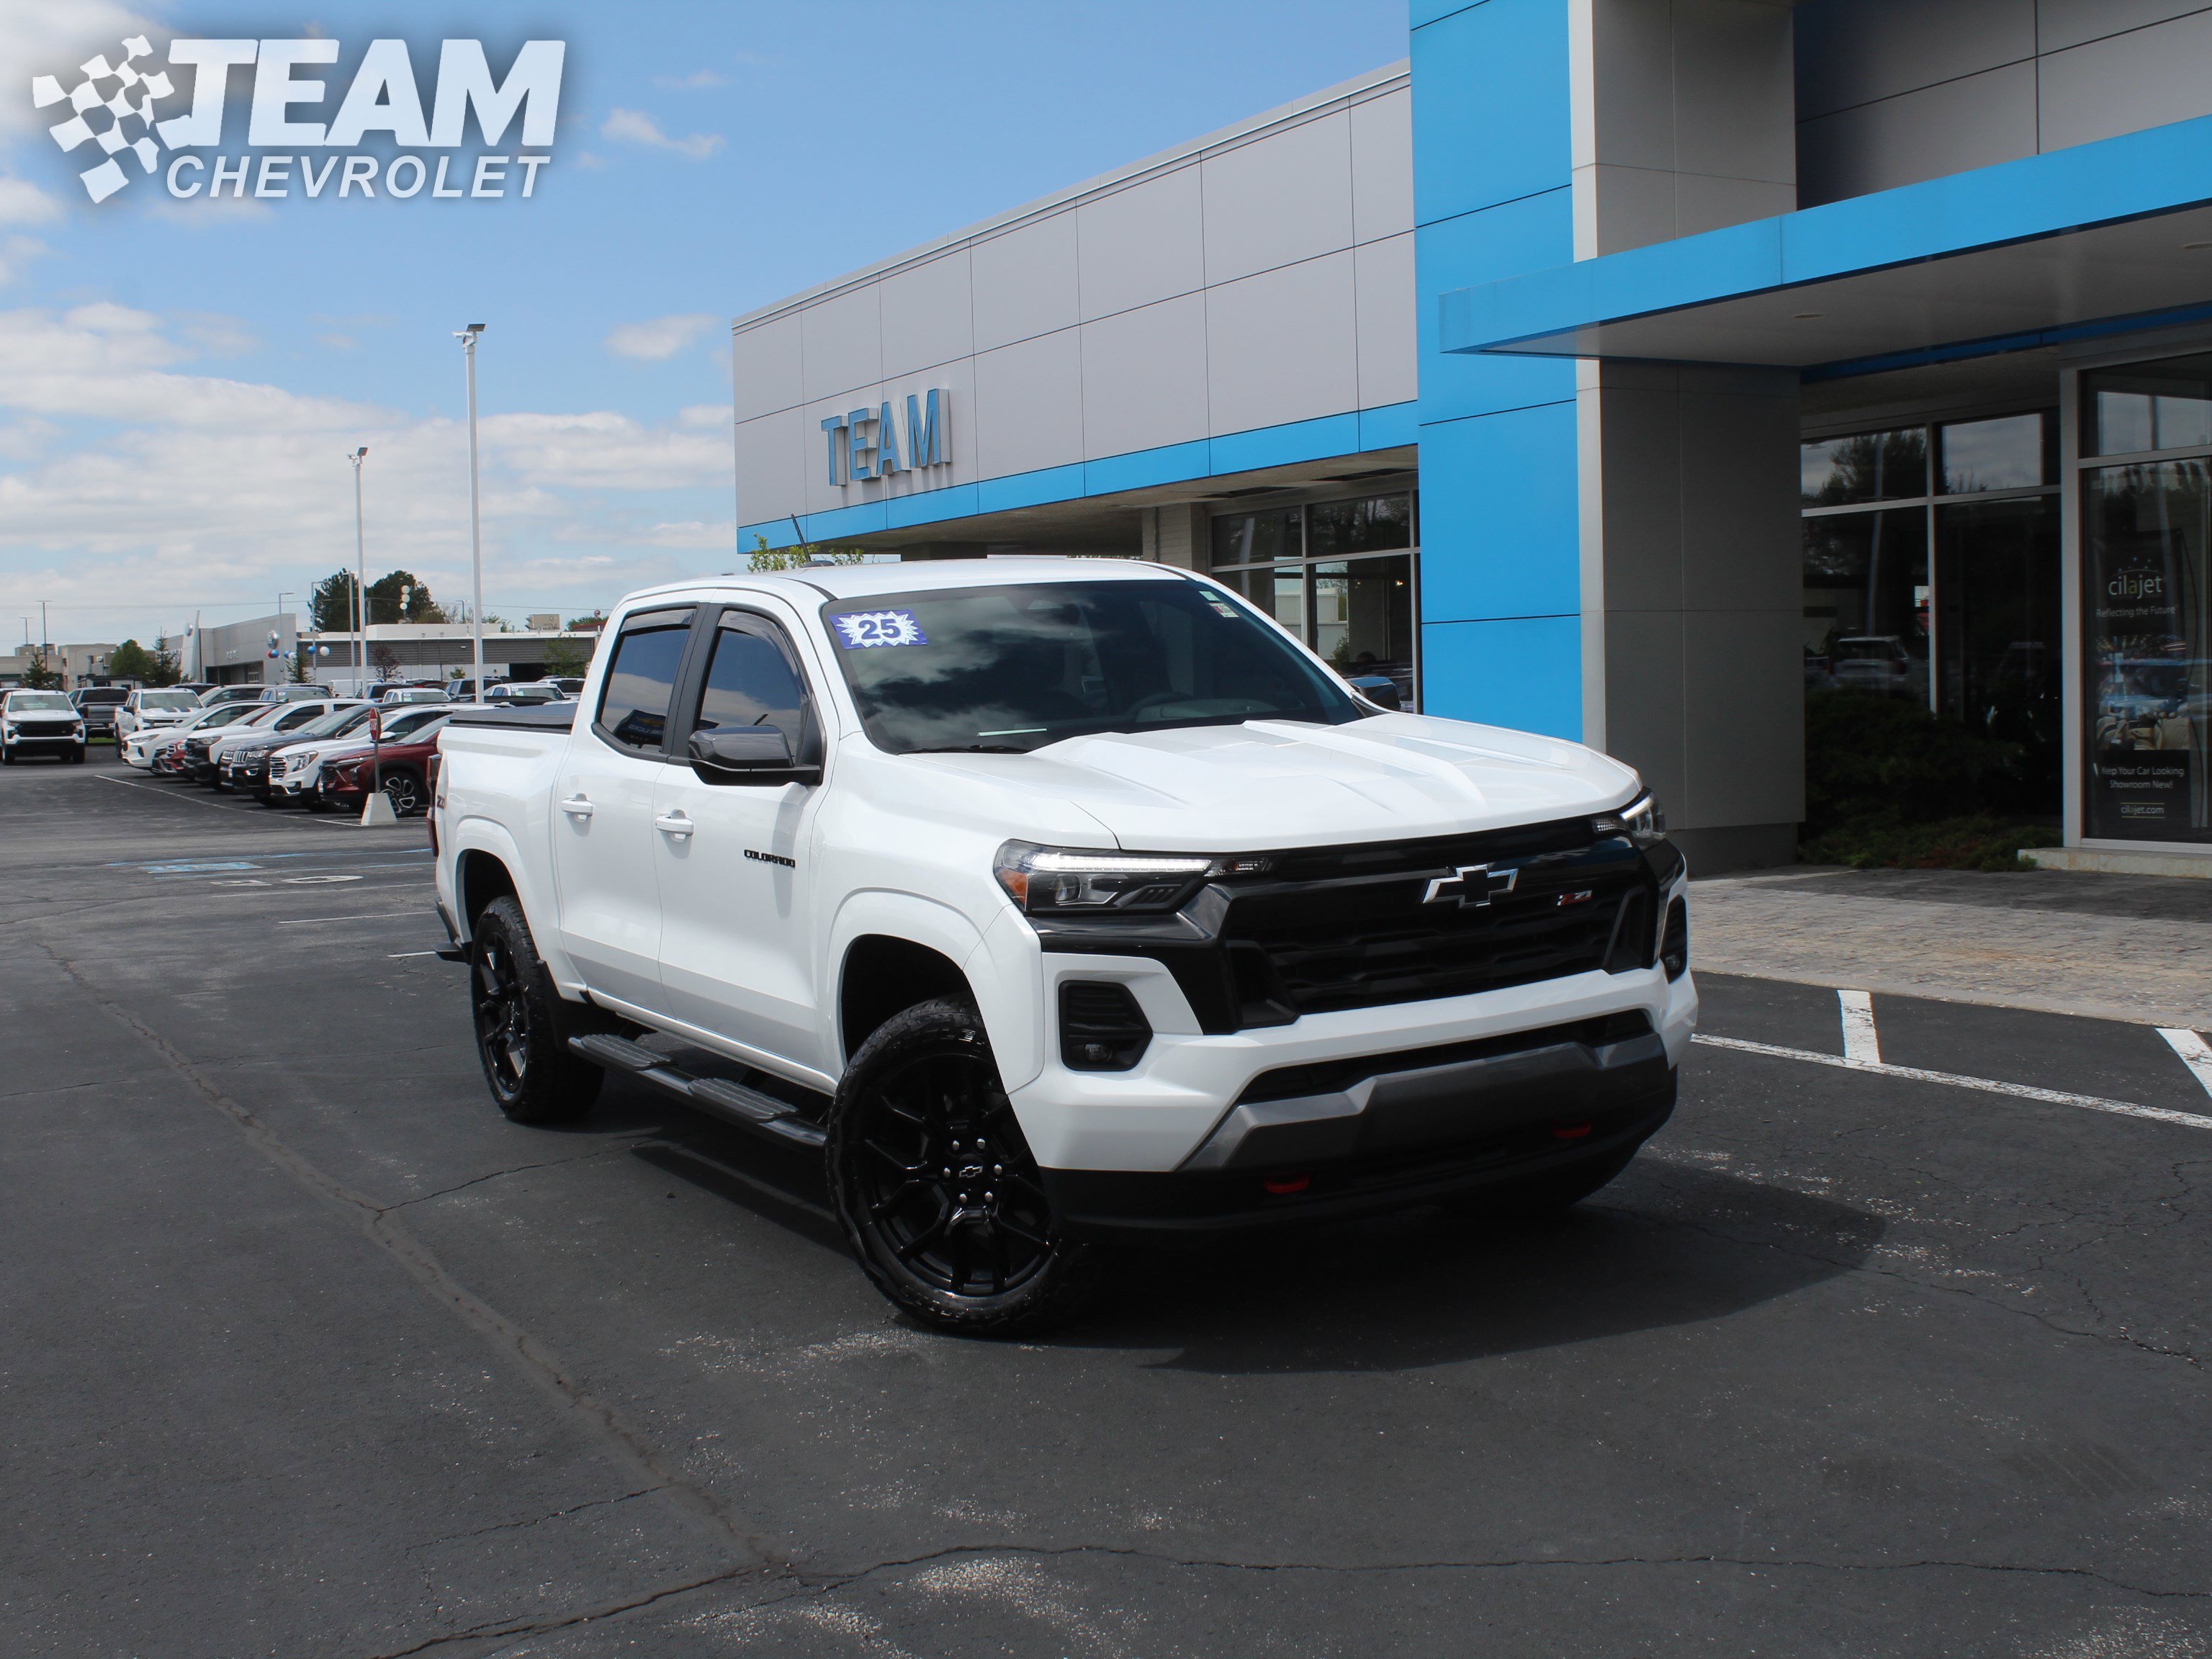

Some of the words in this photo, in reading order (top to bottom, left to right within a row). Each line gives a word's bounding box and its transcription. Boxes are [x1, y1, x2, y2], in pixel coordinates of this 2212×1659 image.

[821, 388, 950, 486] TEAM
[2108, 575, 2162, 599] cilajet
[2096, 608, 2134, 618] Reflecting
[2136, 607, 2149, 616] the
[858, 618, 901, 640] 25
[2136, 766, 2151, 775] Car
[2152, 767, 2185, 777] Looking
[2109, 779, 2151, 788] Showroom
[2152, 780, 2173, 788] New!
[2121, 805, 2164, 815] cilajet.com
[744, 849, 796, 868] COLORADO
